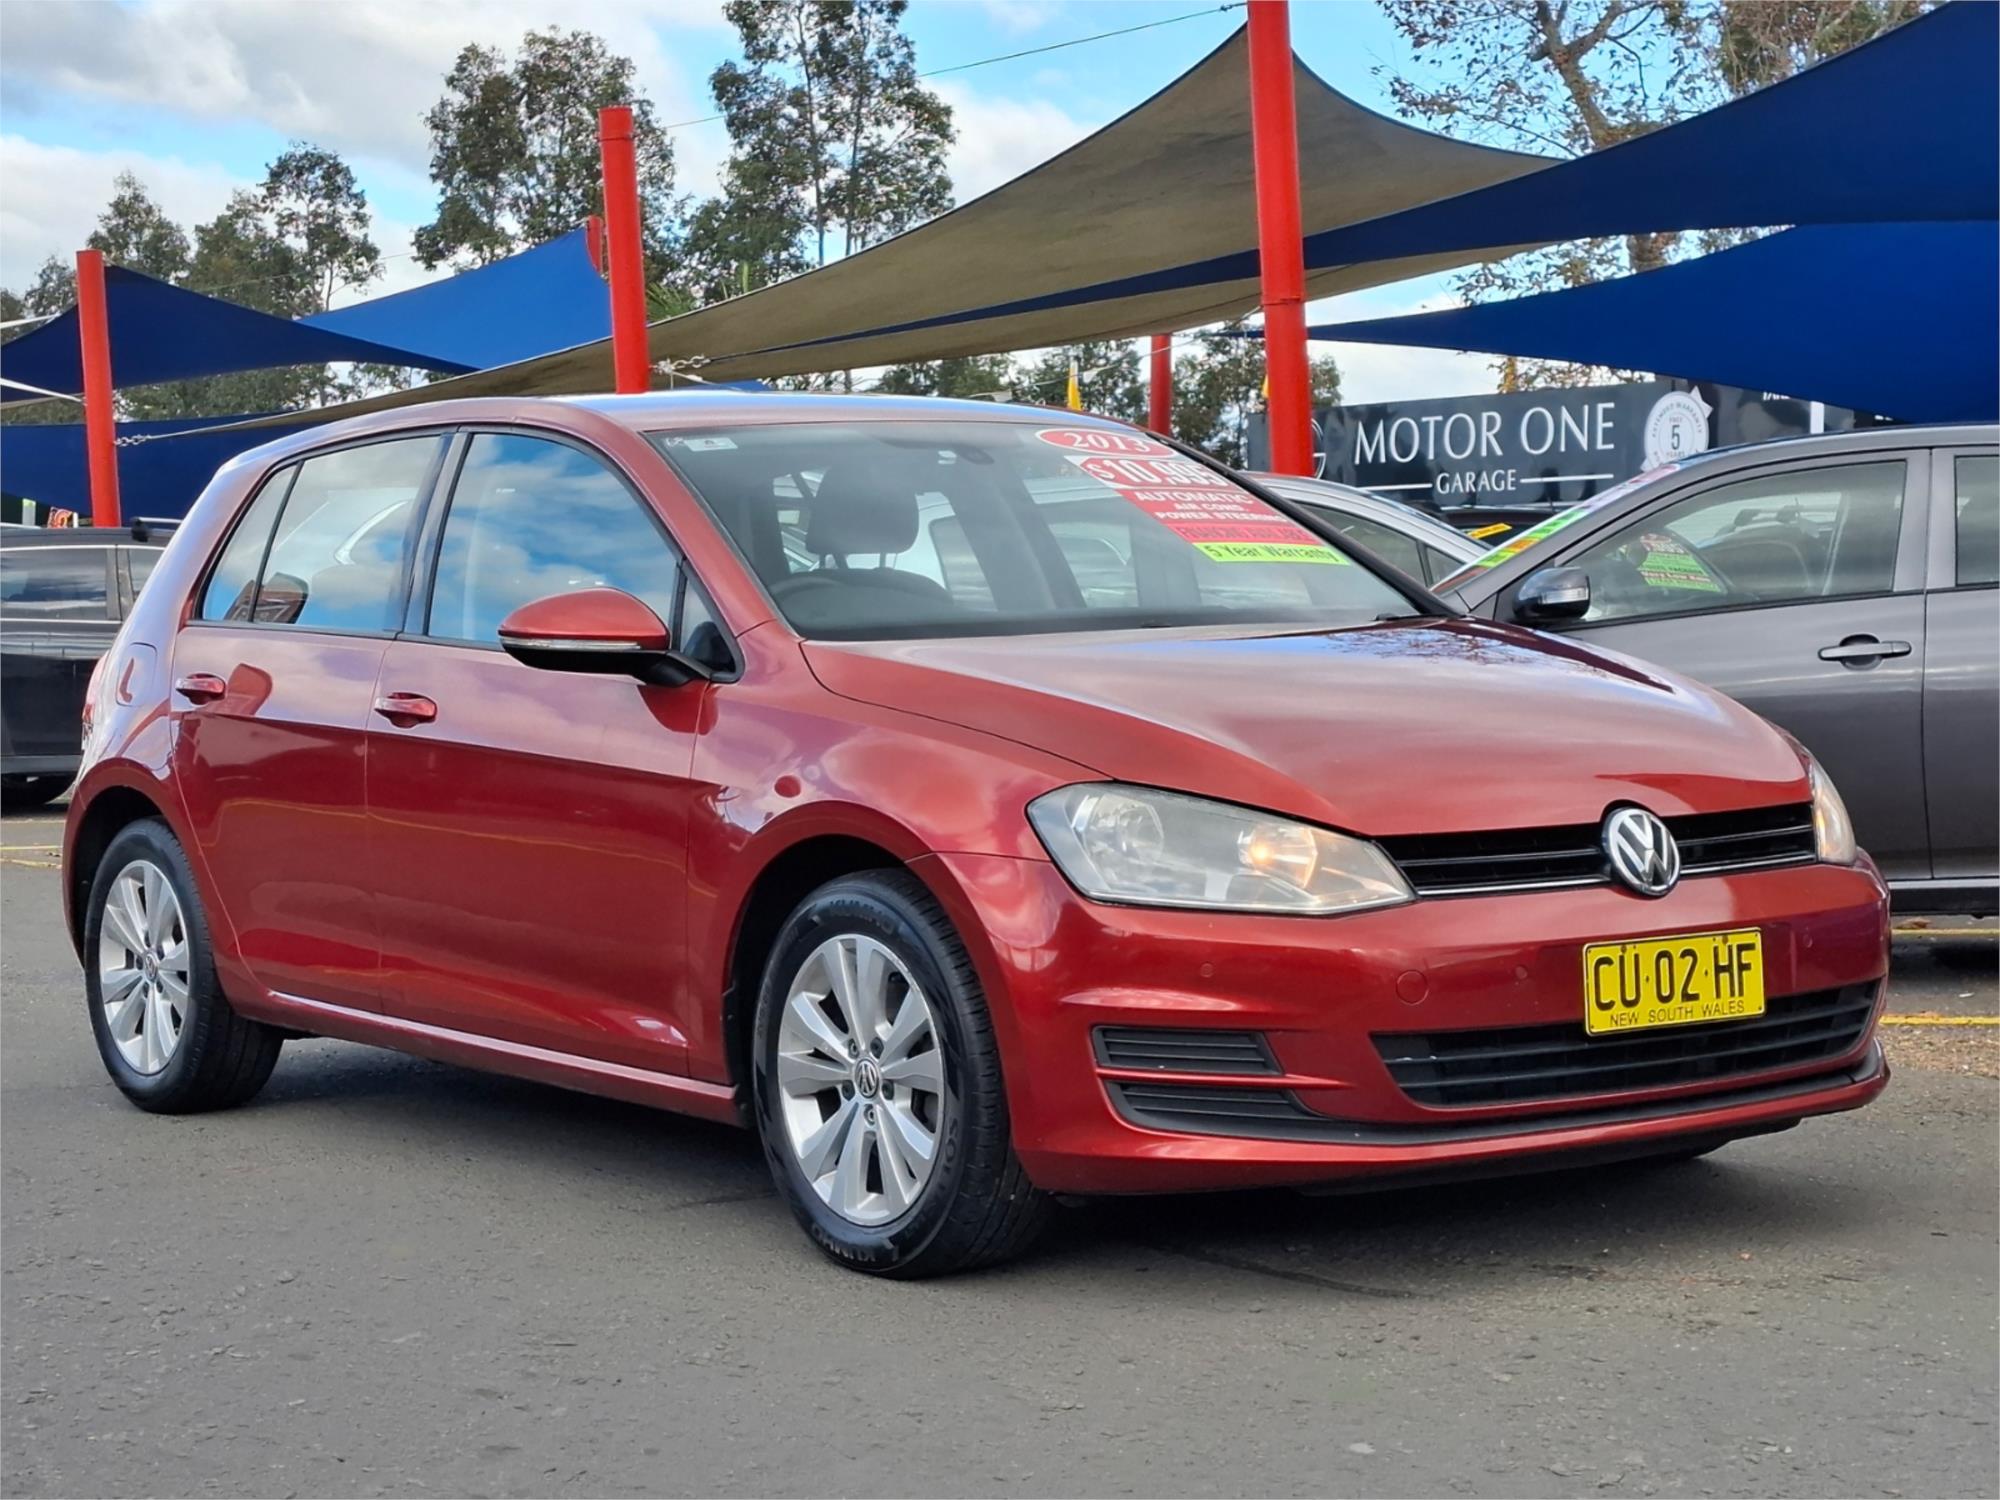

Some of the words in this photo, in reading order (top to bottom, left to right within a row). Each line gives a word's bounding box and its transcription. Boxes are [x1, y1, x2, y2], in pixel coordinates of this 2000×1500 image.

[1063, 432, 1151, 453] 2013
[1354, 411, 1504, 465] MOTOR
[1520, 402, 1615, 455] ONE
[1671, 424, 1681, 450] 5
[1086, 459, 1229, 486] $10,995
[1436, 469, 1517, 495] GARAGE
[1134, 491, 1253, 504] AUTOMATIC
[1154, 511, 1213, 519] POWER
[1204, 545, 1223, 557] 5
[1225, 545, 1260, 557] Year
[1261, 545, 1340, 562] Warranty
[1593, 953, 1642, 1011] CU
[1654, 947, 1700, 1004] 02
[1713, 942, 1756, 999] HF
[1610, 1012, 1640, 1027] NEW
[1648, 1007, 1693, 1023] SOUTH
[1701, 1000, 1745, 1016] WALES
